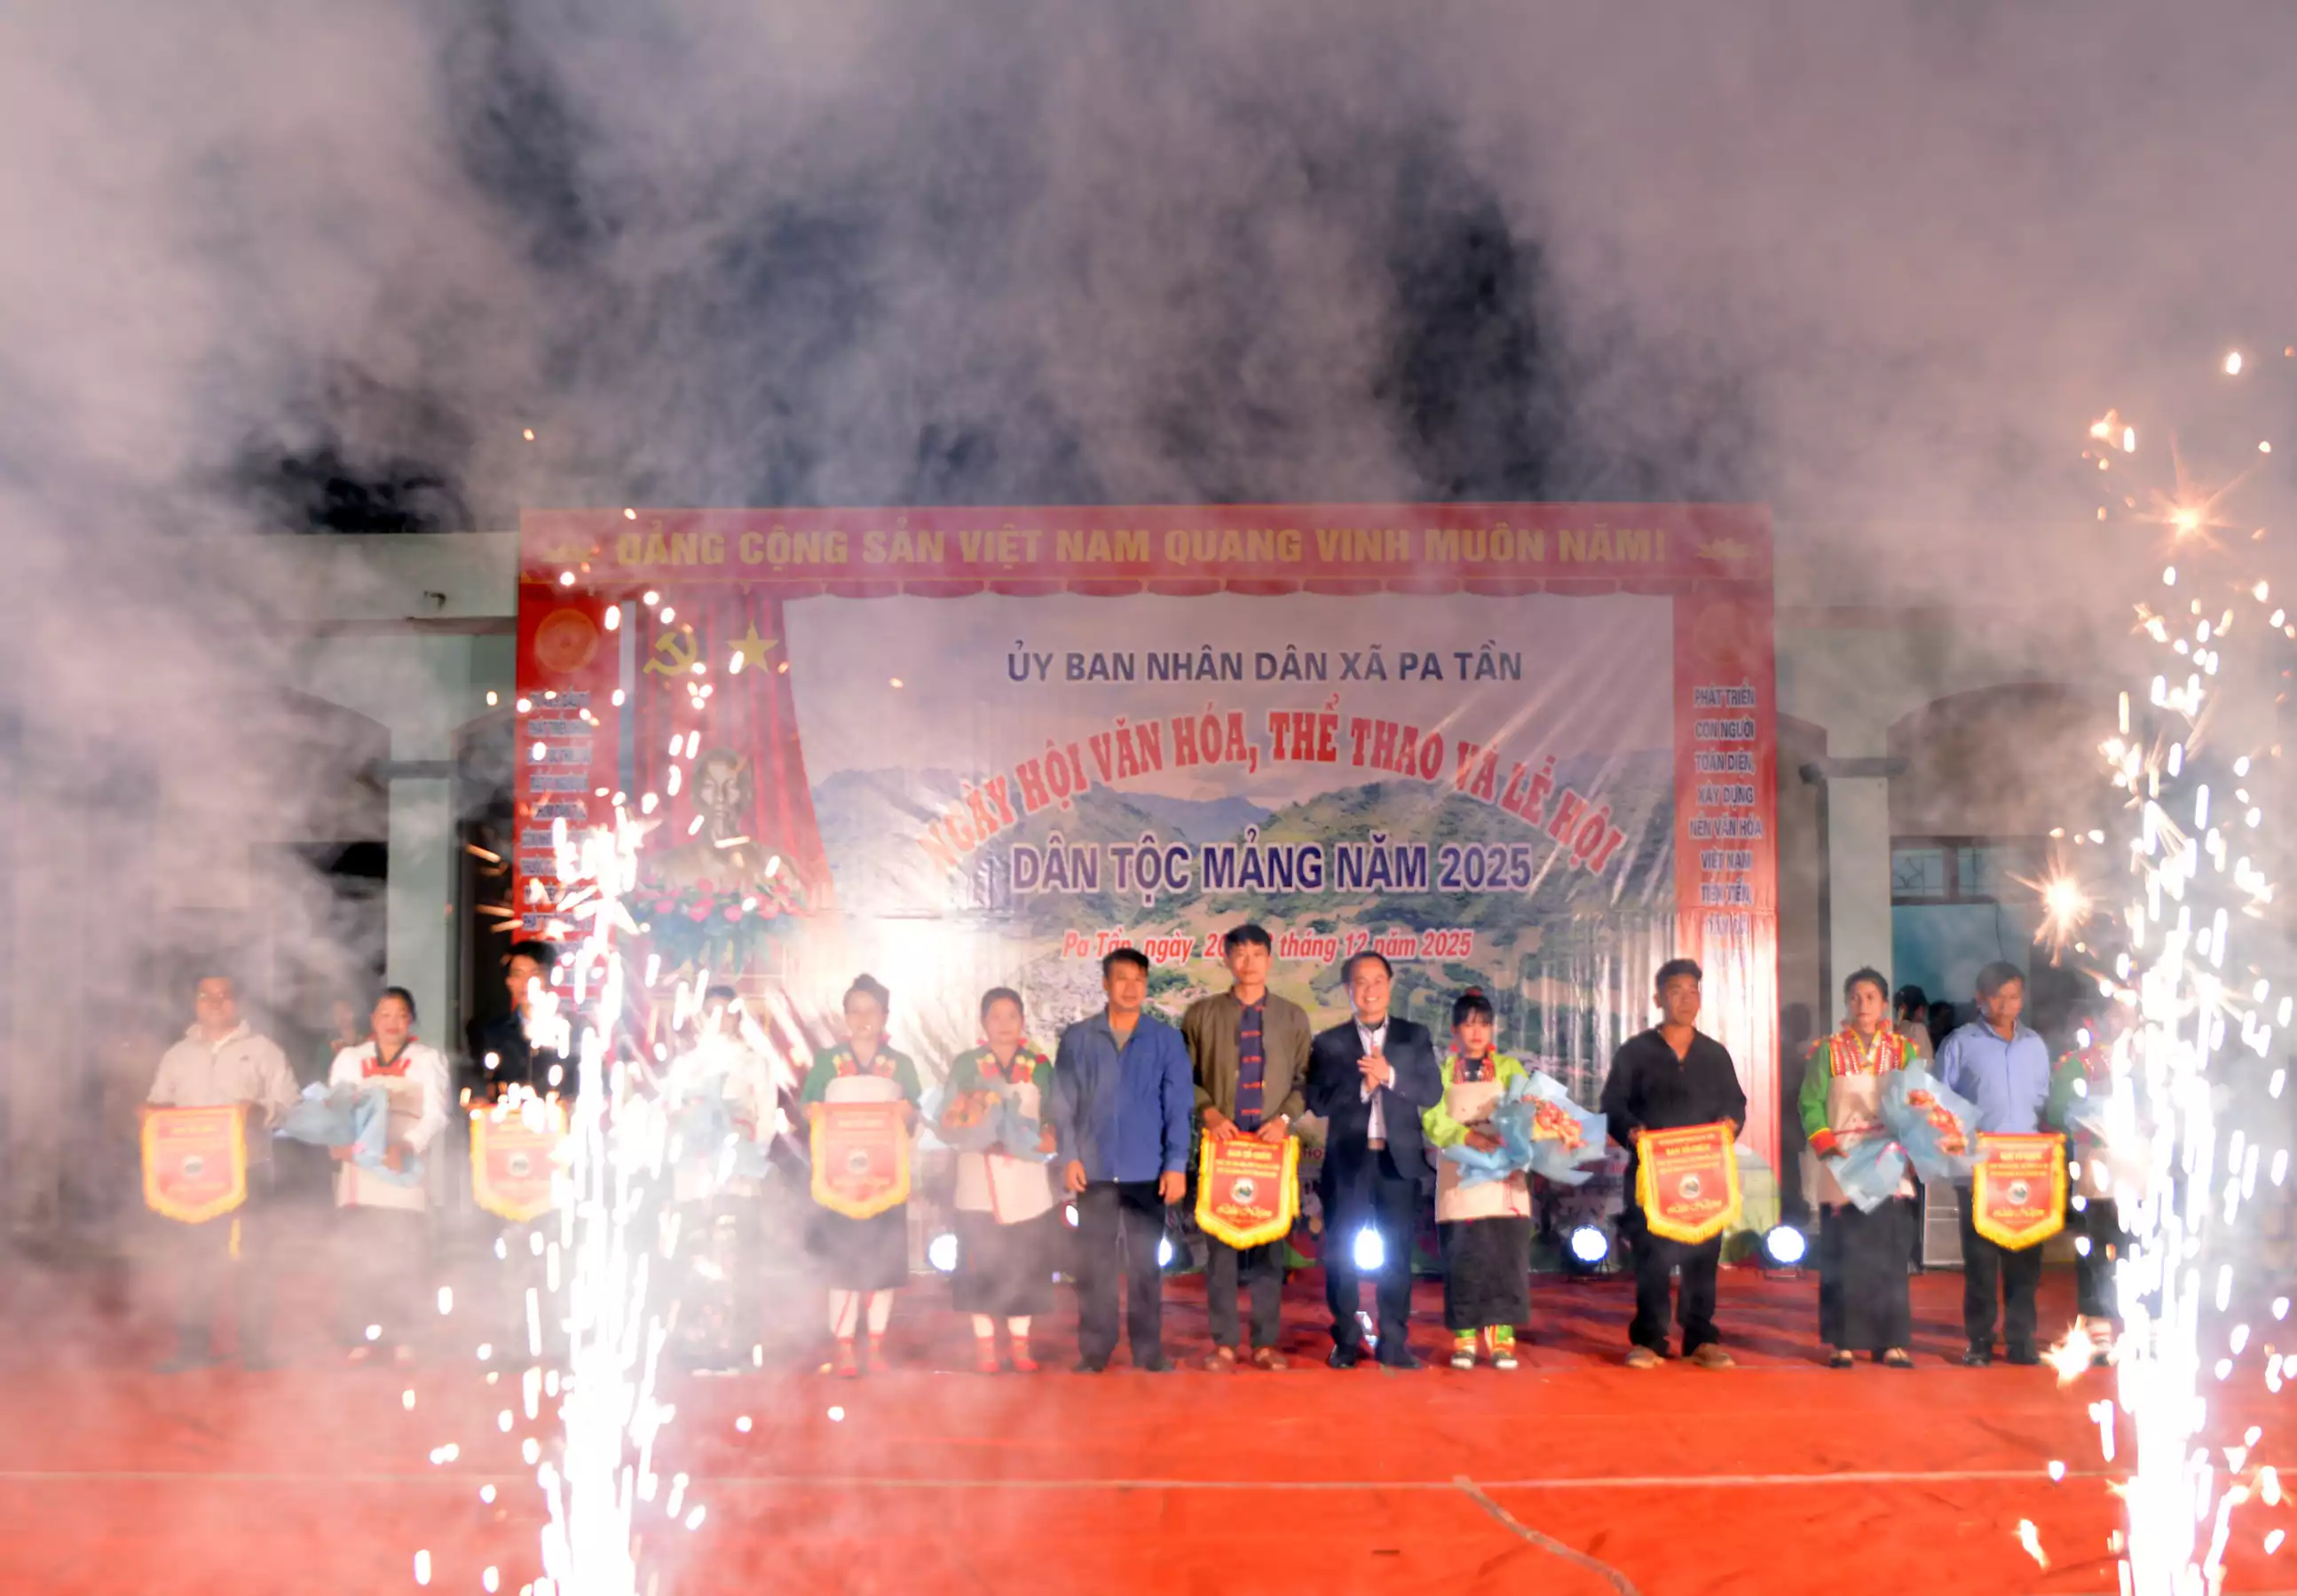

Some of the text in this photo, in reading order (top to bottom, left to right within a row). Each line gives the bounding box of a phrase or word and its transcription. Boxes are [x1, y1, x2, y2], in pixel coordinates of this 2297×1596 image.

[738, 523, 848, 573] CỘNG
[862, 517, 944, 564] SẢN
[959, 523, 1042, 570] VIỆT
[1056, 529, 1150, 563] NAM
[1164, 528, 1302, 565] QUANG
[1314, 528, 1409, 562] VINH
[1425, 521, 1545, 562] MUÔN
[1559, 523, 1665, 562] NĂM!
[1007, 638, 1522, 681] ỦY BAN NHÂN DÂN XÃ PA TẦN
[1695, 721, 1717, 739] CON
[917, 774, 1014, 872] NGÀY
[1015, 739, 1088, 811] HỘI
[1088, 717, 1163, 782] VĂN
[1171, 702, 1258, 774] HÓA,
[1269, 692, 1339, 762] THỂ
[1350, 716, 1443, 780] THAO
[1456, 741, 1499, 802] VÀ
[1548, 789, 1623, 873] HỘI
[1014, 827, 1532, 904] DÂN TỘC MẢNG NĂM 2025
[1063, 932, 1090, 958] Pa
[1145, 934, 1193, 964] ngày
[1280, 932, 1337, 963] tháng
[1345, 933, 1368, 956] 12
[1374, 932, 1417, 957] năm
[1422, 932, 1473, 958] 2025
